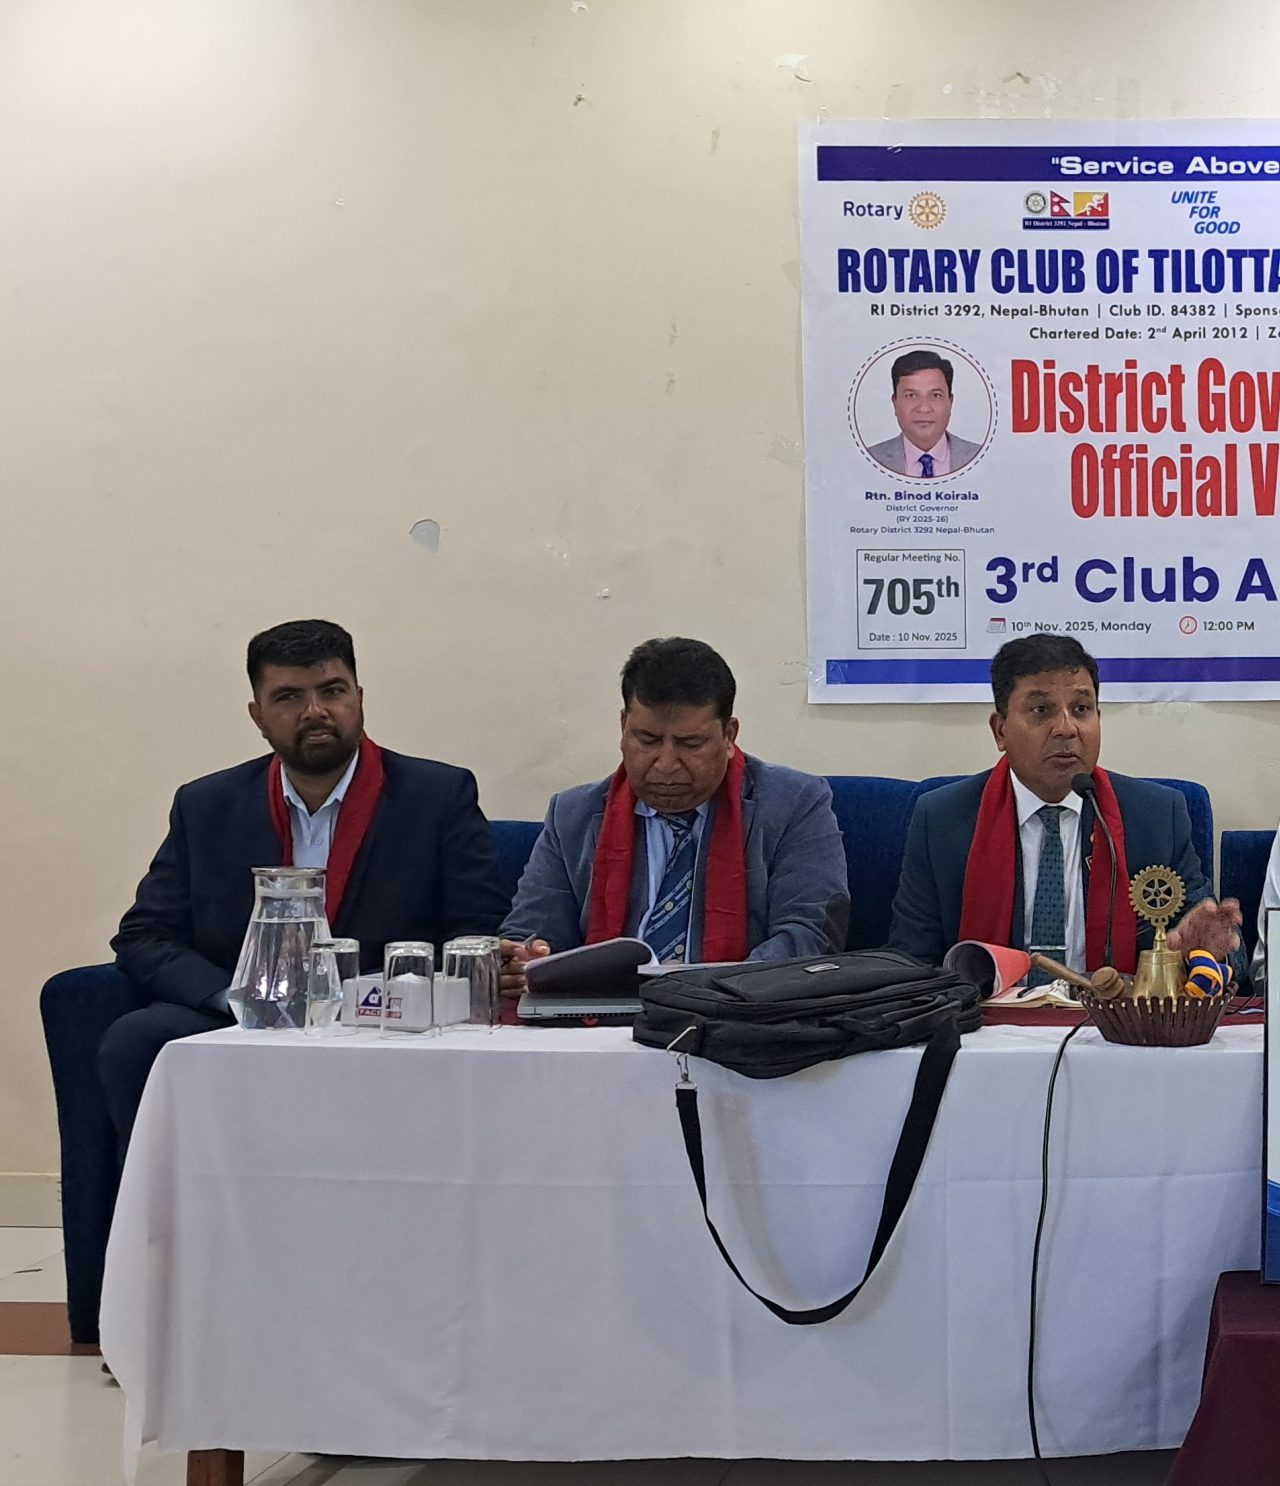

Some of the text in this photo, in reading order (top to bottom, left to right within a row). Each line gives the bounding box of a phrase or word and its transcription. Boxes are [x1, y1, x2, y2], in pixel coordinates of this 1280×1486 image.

[1051, 155, 1174, 175] "Service
[1186, 155, 1280, 175] Above
[1171, 190, 1217, 204] UNITE
[843, 201, 904, 220] Rotary
[1189, 206, 1222, 219] FOR
[1194, 221, 1241, 235] GOOD
[837, 246, 981, 295] ROTARY
[990, 246, 1086, 295] CLUB
[1095, 246, 1139, 295] OF
[870, 303, 885, 317] RI
[890, 303, 939, 317] District
[944, 303, 986, 320] 3292,
[990, 302, 1090, 320] Nepal-Bhutan
[1109, 303, 1142, 317] Club
[1147, 303, 1165, 317] ID.
[1170, 303, 1216, 317] 84382
[1029, 325, 1100, 340] Chartered
[1104, 325, 1142, 340] Date:
[1147, 325, 1167, 340] 2nd
[1172, 325, 1207, 343] April
[1211, 325, 1248, 340] 2012
[1010, 358, 1188, 434] District
[1070, 442, 1238, 519] Official
[864, 490, 980, 501] Rtn. Binod Koirala
[885, 503, 959, 513] District Governor
[896, 514, 949, 524] (RY 2025-26)
[849, 525, 996, 536] Rotary District 3292 Nepal-Bhutan
[863, 552, 961, 566] Regular Meeting No.
[985, 555, 1060, 604] 3rd
[1074, 555, 1221, 604] Club
[862, 575, 960, 616] 705th
[1011, 619, 1152, 635] 10th Nov. 2025, Monday
[1203, 620, 1255, 632] 12:00 PM
[869, 632, 891, 643] Date
[898, 632, 910, 642] 10
[911, 632, 932, 642] Nov.
[933, 632, 958, 642] 2025
